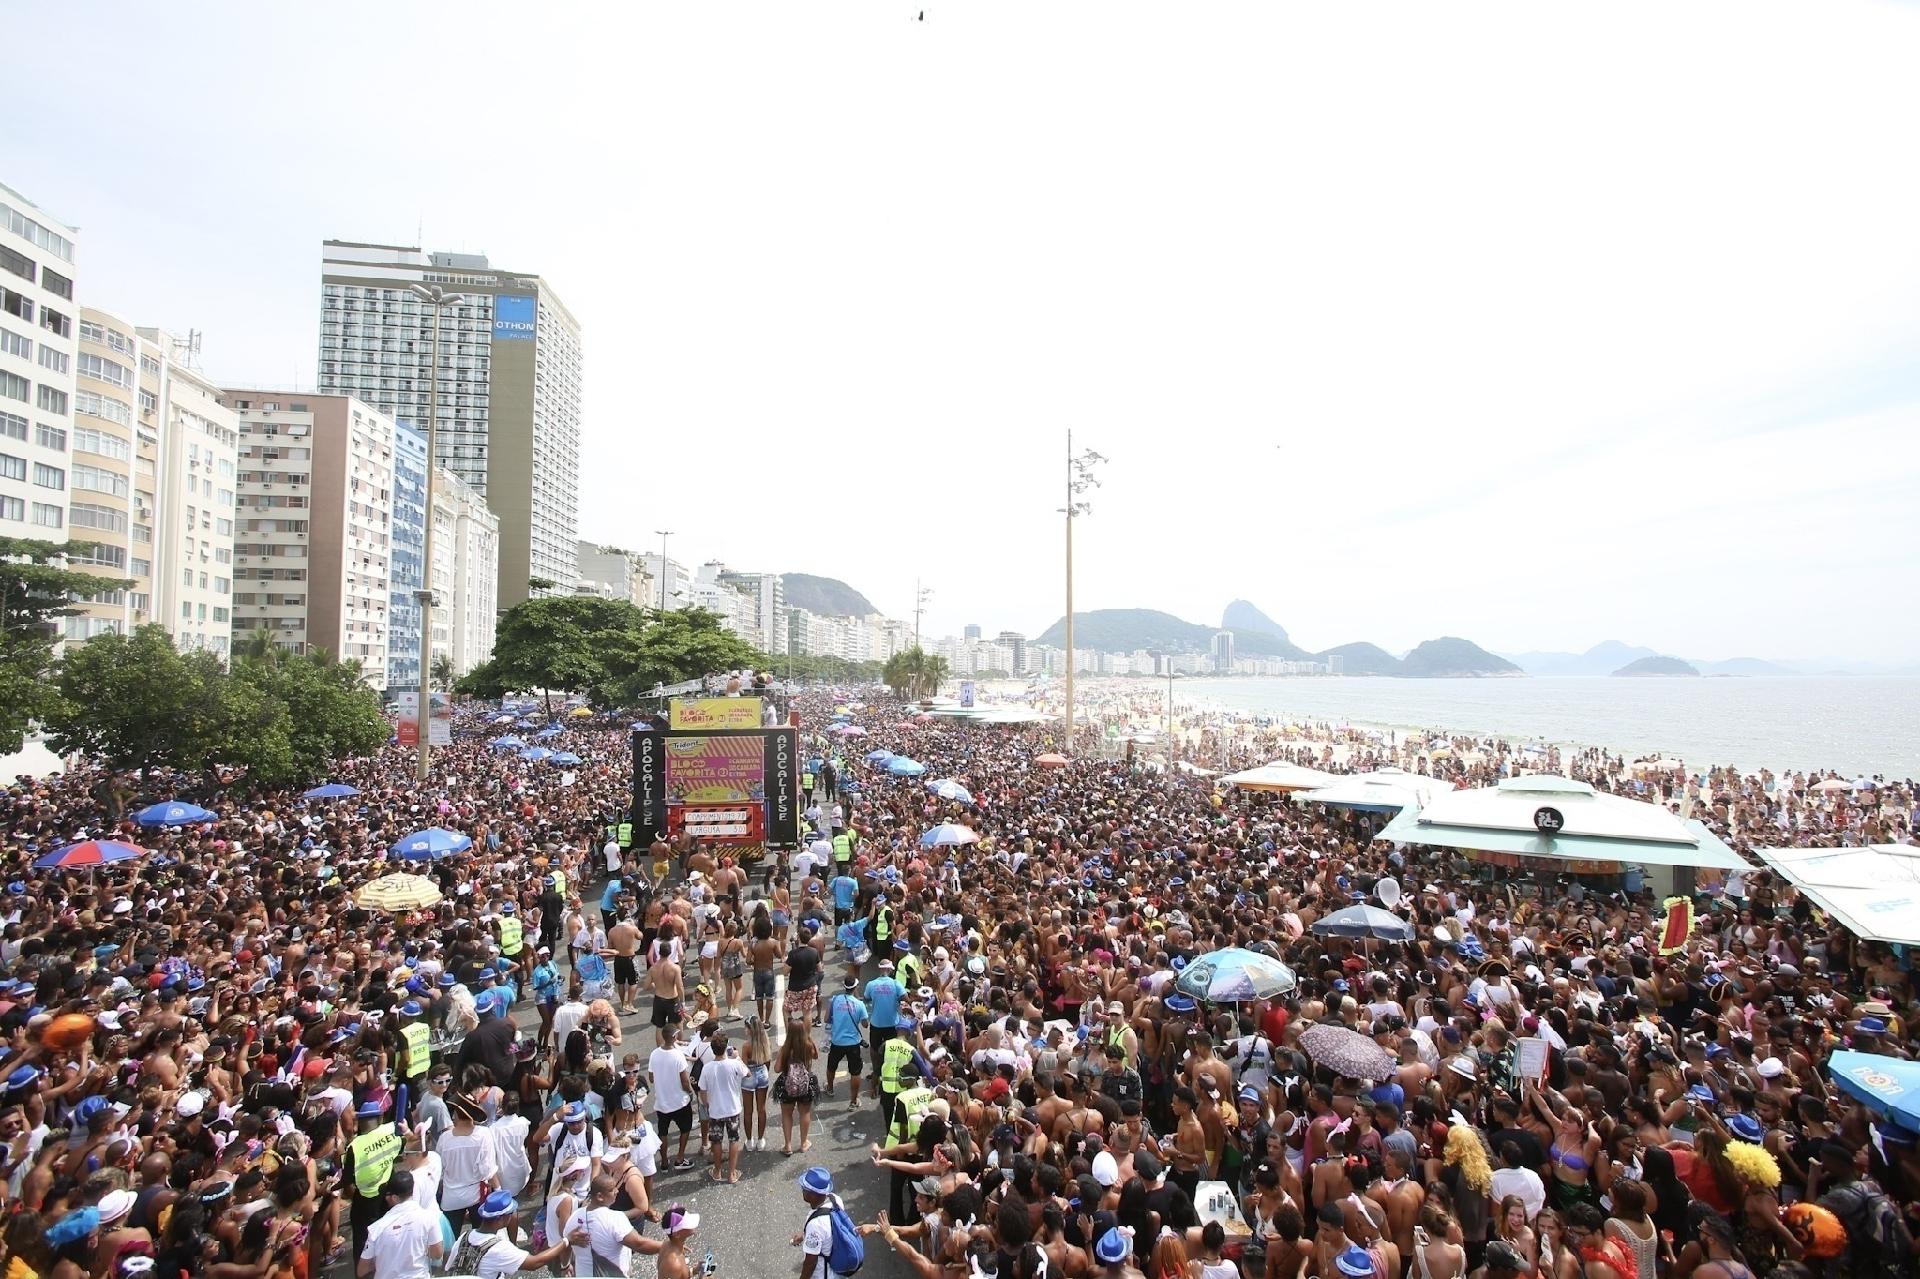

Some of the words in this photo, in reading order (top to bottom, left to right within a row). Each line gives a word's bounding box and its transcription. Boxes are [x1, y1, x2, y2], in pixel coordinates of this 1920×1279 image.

[495, 321, 534, 330] OTHON
[679, 714, 714, 723] FAVORITA
[672, 741, 700, 749] Trident
[670, 769, 716, 777] FAVORITA
[776, 734, 788, 821] APOCALIPSE
[641, 737, 653, 826] APOCALIPSE
[1537, 811, 1552, 821] 51
[888, 1045, 912, 1057] SUNSET
[363, 1133, 396, 1155] SUNSET
